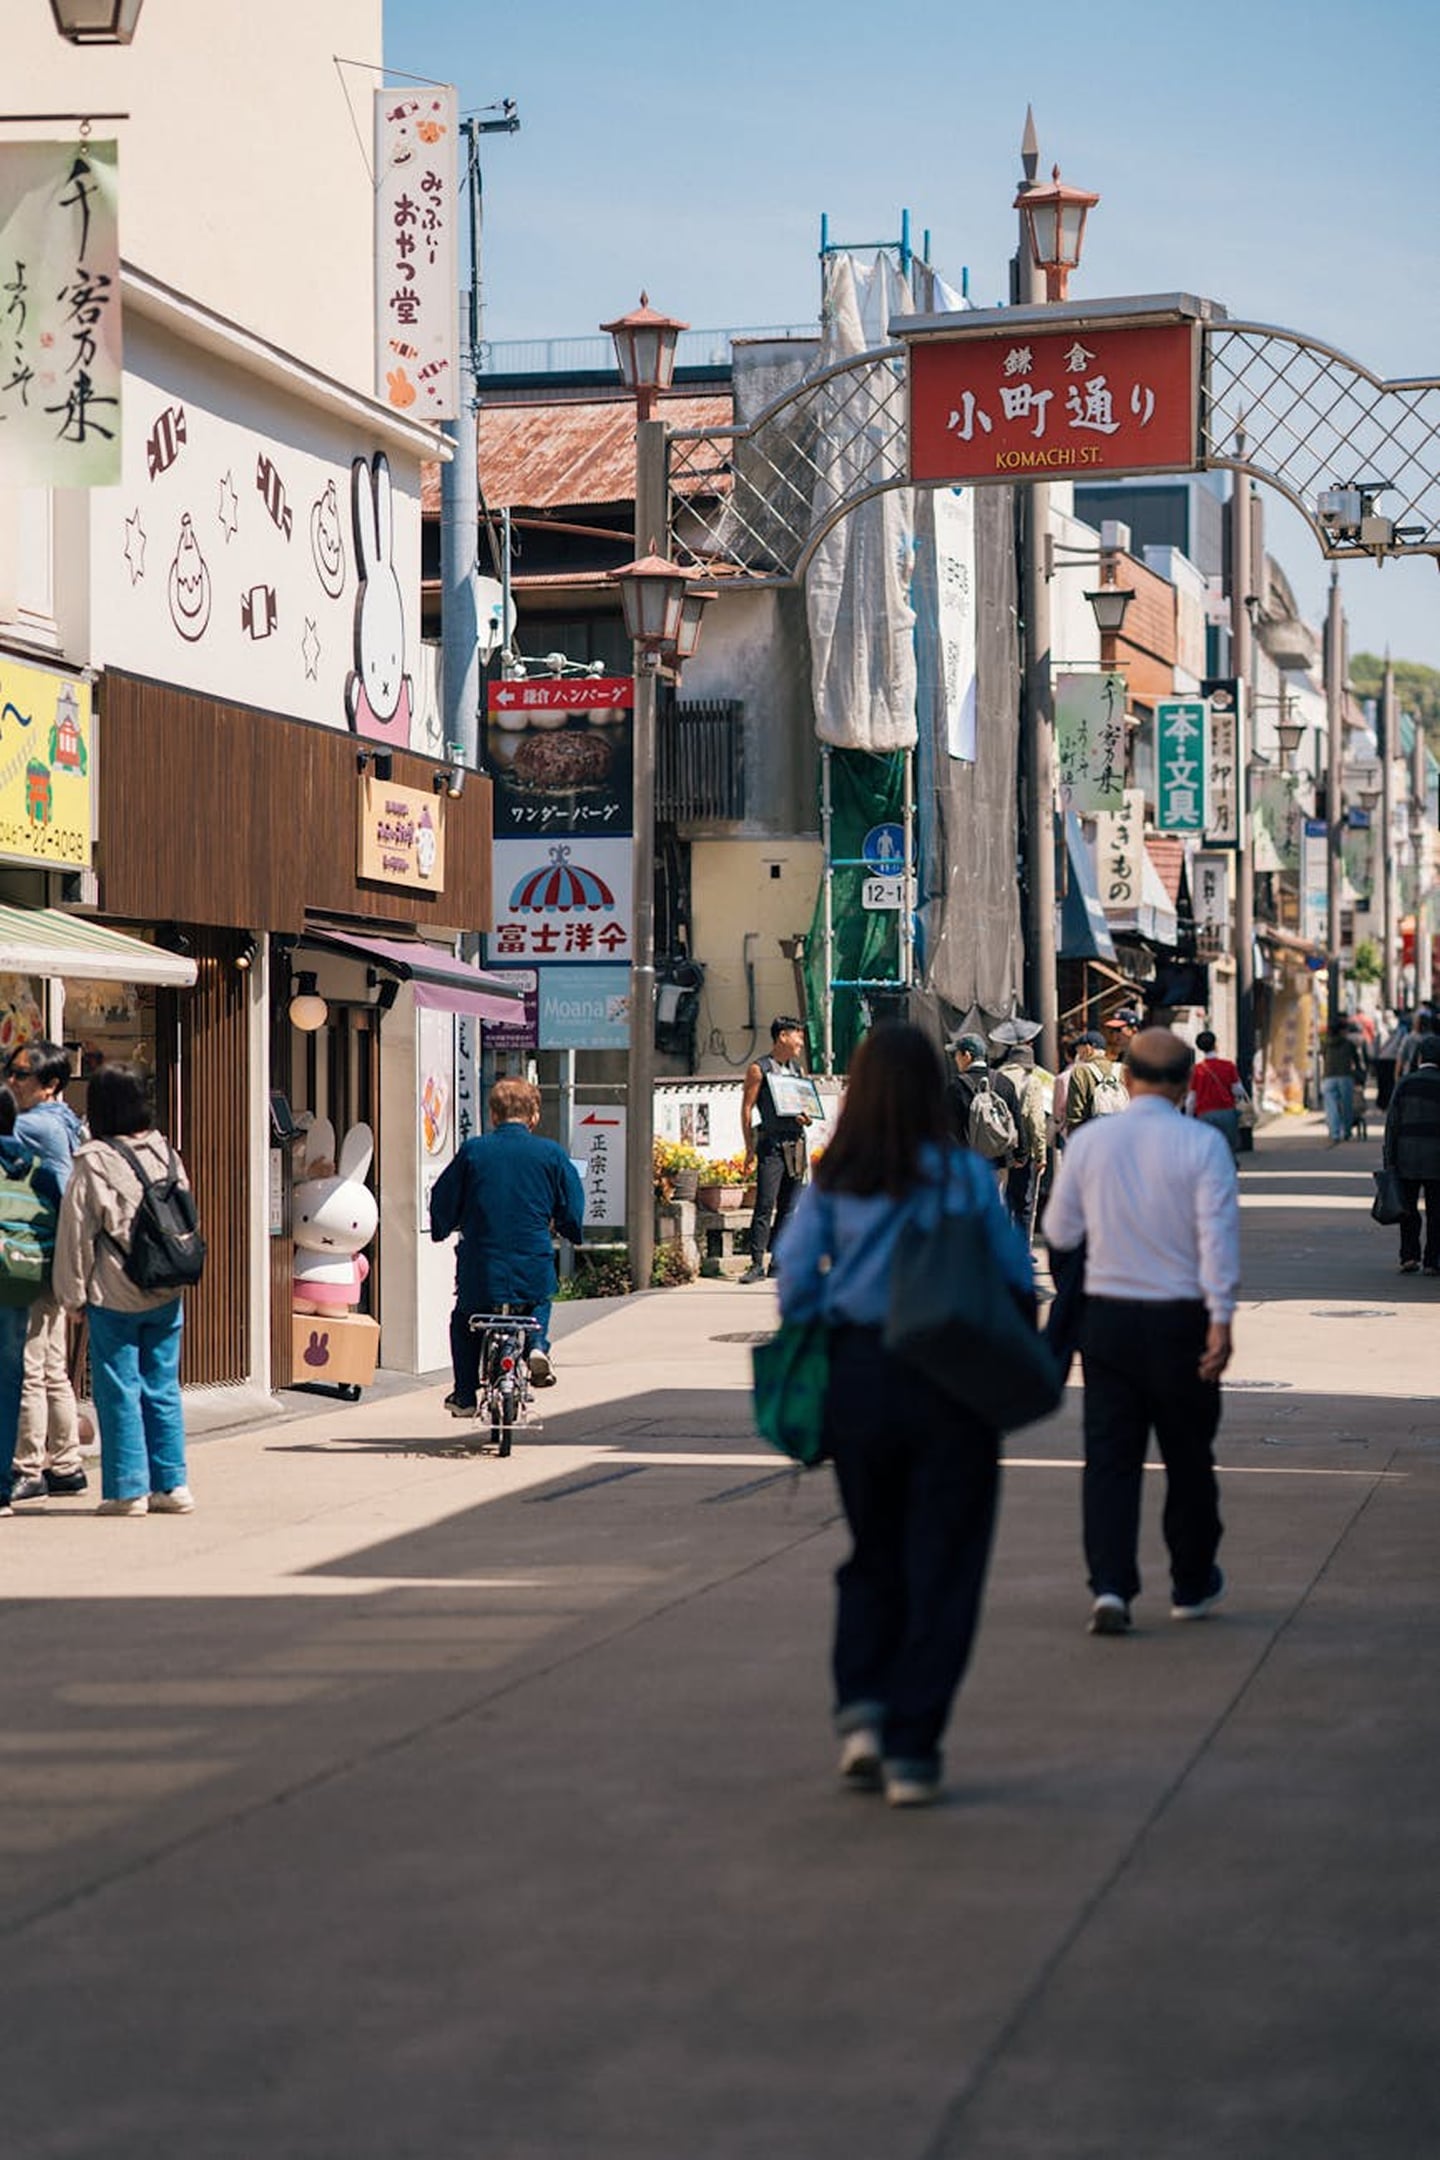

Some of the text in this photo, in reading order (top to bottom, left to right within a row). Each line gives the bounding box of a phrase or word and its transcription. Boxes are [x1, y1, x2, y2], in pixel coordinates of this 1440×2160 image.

[421, 171, 443, 264] みっふぃー
[390, 193, 421, 324] おやつ堂
[2, 260, 34, 407] ようこそ
[45, 158, 118, 442] 千客万来
[1003, 342, 1096, 376] 鎌倉
[947, 376, 1154, 440] 小町通り
[996, 447, 1103, 468] KOMACHI ST.
[868, 885, 914, 902] 12-1
[543, 997, 604, 1018] Moana
[589, 1134, 607, 1219] 正宗工芸
